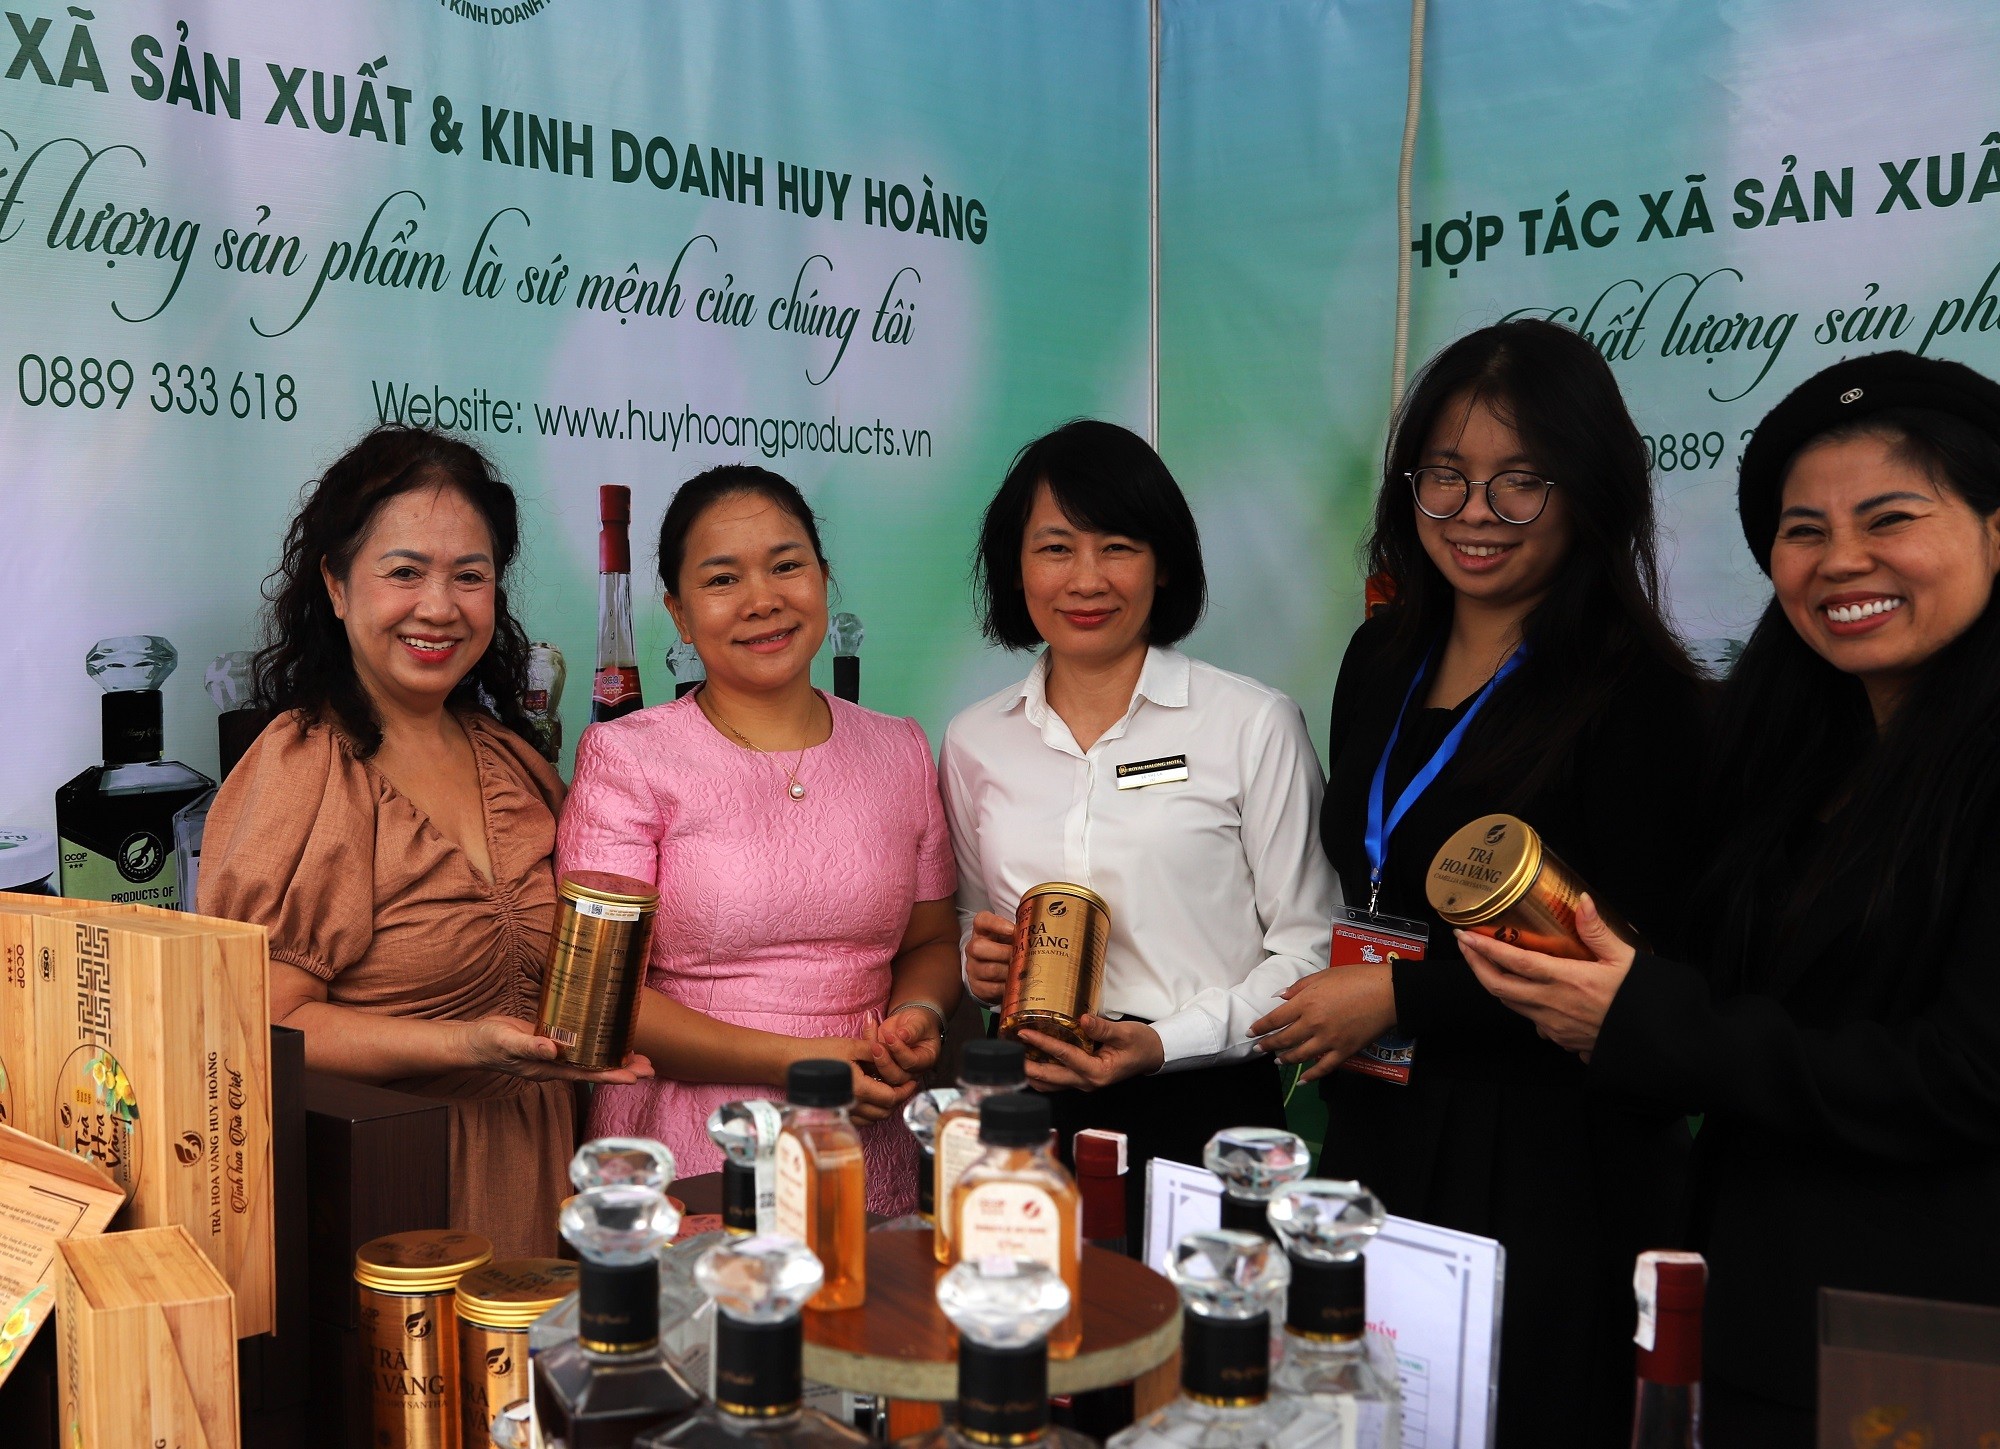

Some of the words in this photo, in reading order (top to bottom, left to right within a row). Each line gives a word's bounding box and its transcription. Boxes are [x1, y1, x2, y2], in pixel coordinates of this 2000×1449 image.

[490, 0, 544, 25] DOANH
[4, 6, 109, 93] XÃ
[131, 20, 240, 119] SẢN
[264, 55, 412, 146] XUẤT
[430, 96, 464, 156] &
[482, 105, 593, 178] KINH
[612, 128, 764, 206] DOANH
[778, 161, 852, 220] HUY
[865, 174, 988, 244] HOÀNG
[1519, 189, 1620, 256] TÁC
[1636, 173, 1715, 242] XÃ
[1732, 154, 1854, 230] SẢN
[47, 145, 200, 322] lượng
[214, 205, 307, 276] sản
[463, 207, 530, 300] là
[250, 190, 450, 338] phẩm
[517, 253, 570, 304] sứ
[577, 235, 717, 325] mệnh
[696, 274, 757, 328] của
[768, 255, 861, 386] chúng
[871, 267, 921, 346] tôi
[1661, 268, 1798, 403] lượng
[1814, 283, 1915, 346] sản
[18, 353, 134, 410] 0889
[151, 362, 219, 416] 333
[229, 371, 298, 422] 618
[372, 380, 521, 433] Website:
[533, 400, 931, 458] www.huyhoangproducts.vn
[64, 851, 88, 862] OCOP
[1439, 858, 1469, 877] HOA
[1468, 864, 1502, 885] VÀNG
[1467, 847, 1494, 864] TRÀ
[111, 888, 159, 903] PRODUCTS
[162, 886, 174, 898] OF
[1020, 921, 1047, 939] TRÀ
[1027, 935, 1069, 950] VÀNG
[16, 944, 25, 989] OCOP
[206, 1052, 217, 1100] HOÀNG
[224, 1058, 247, 1110] Việt
[75, 1113, 91, 1154] Trà
[91, 1113, 107, 1161] Hoa
[106, 1114, 132, 1168] Vàng
[208, 1104, 219, 1132] HUY
[228, 1114, 248, 1147] Trà
[207, 1135, 220, 1172] VÀNG
[211, 1176, 221, 1206] HOA
[209, 1209, 221, 1236] TRÀ
[382, 1372, 445, 1396] VÀNG
